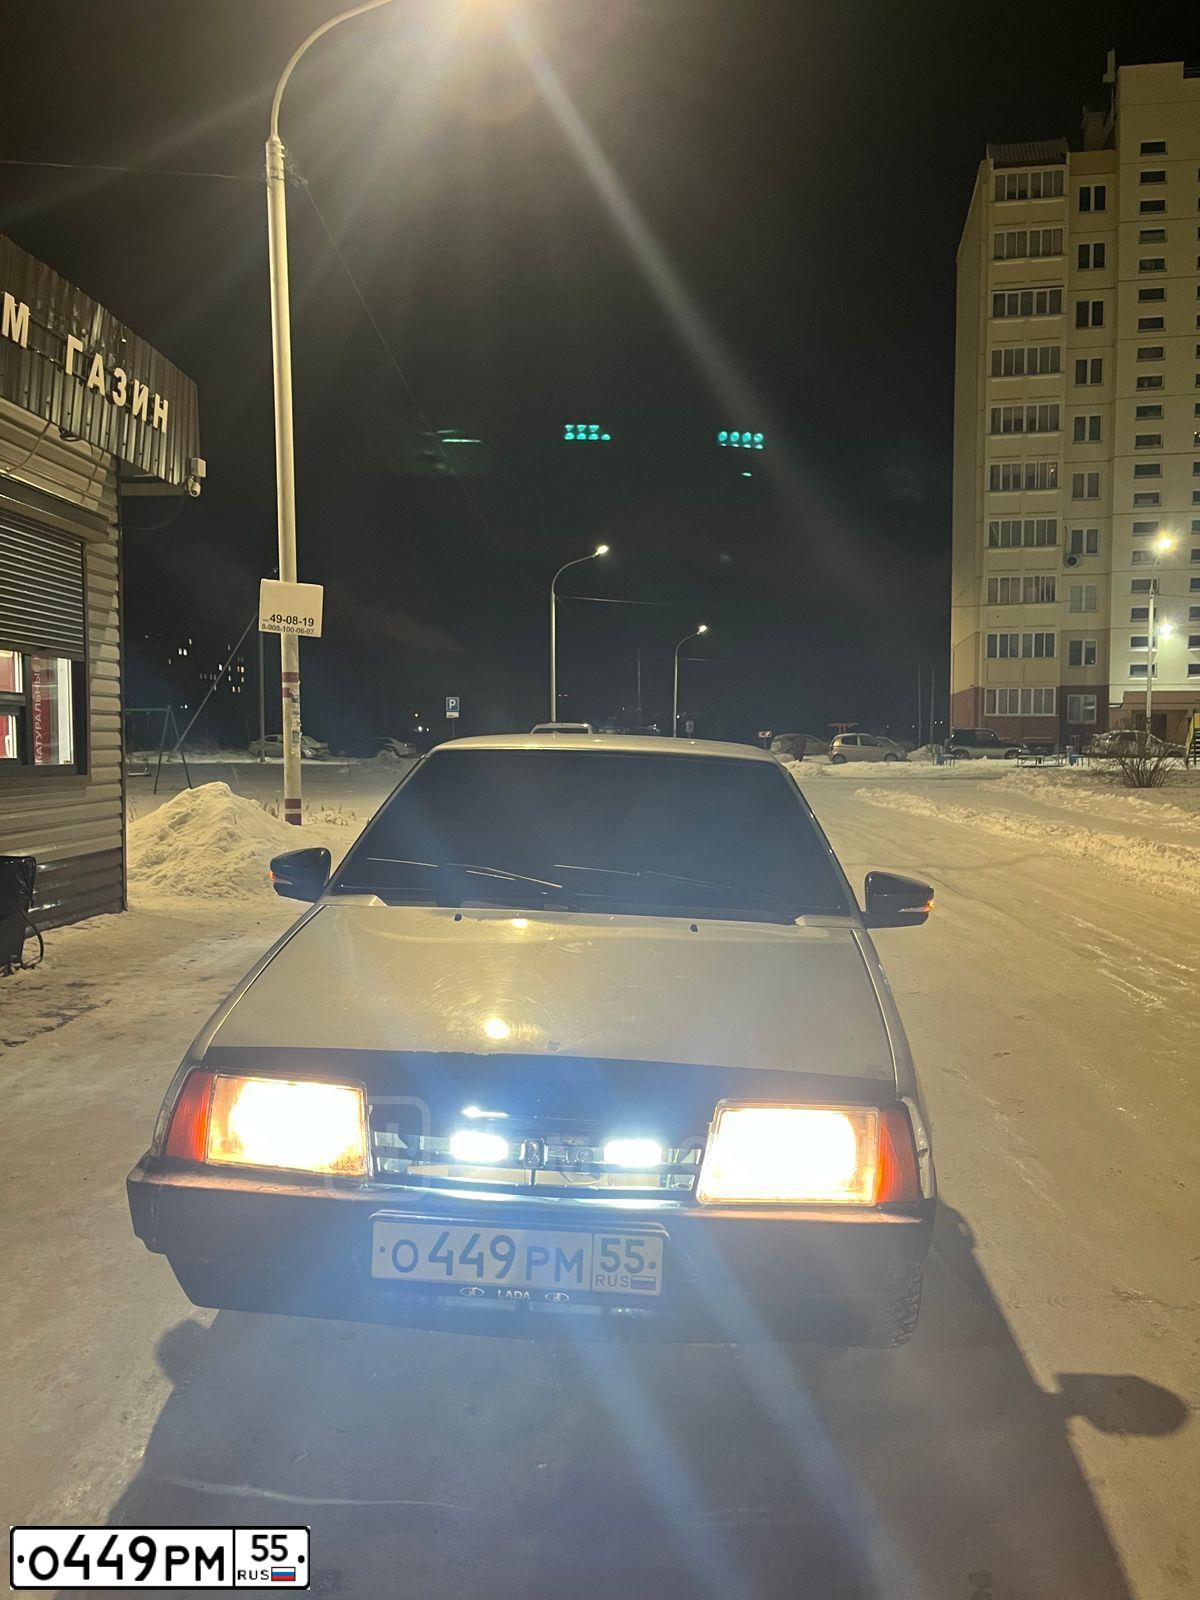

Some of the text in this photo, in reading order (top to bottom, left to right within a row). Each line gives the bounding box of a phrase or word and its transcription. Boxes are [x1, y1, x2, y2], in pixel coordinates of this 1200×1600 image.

[270, 613, 314, 626] 49-08-19
[599, 1237, 646, 1274] 55
[595, 1274, 630, 1288] RUS
[497, 1289, 531, 1300] LADA
